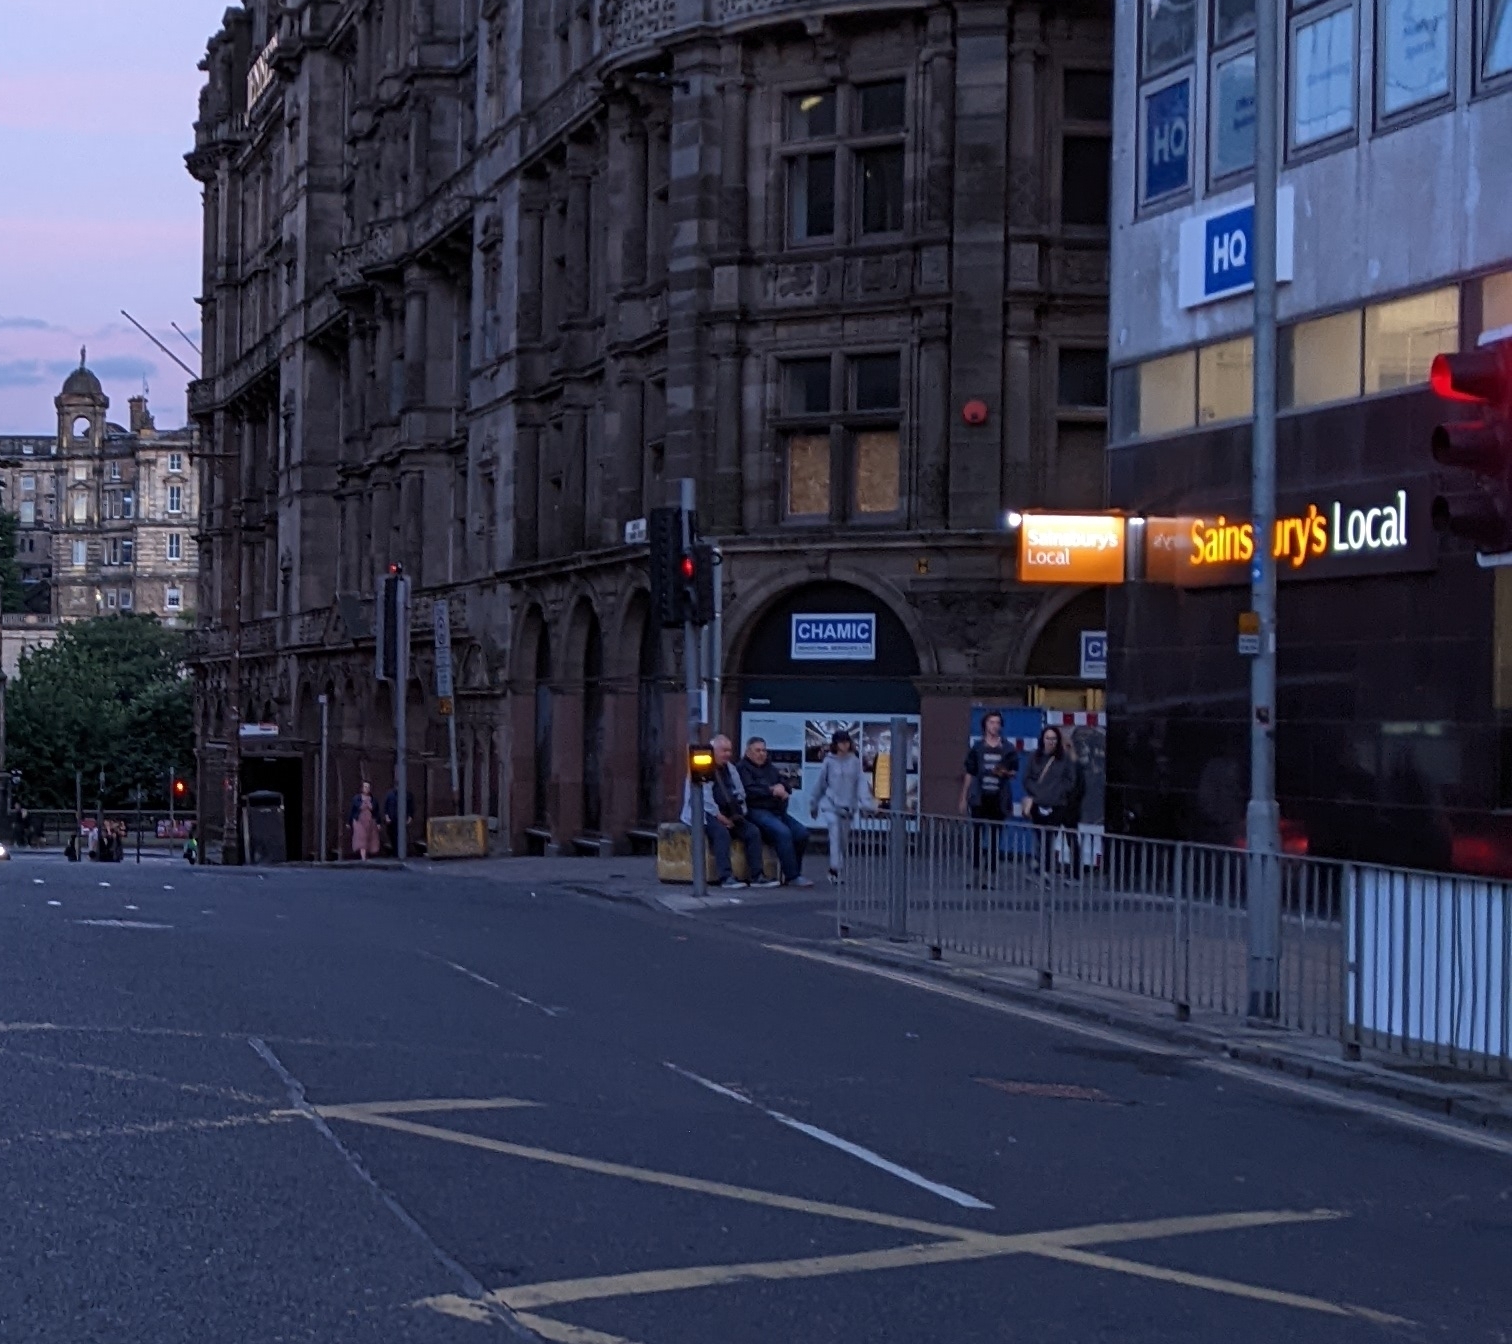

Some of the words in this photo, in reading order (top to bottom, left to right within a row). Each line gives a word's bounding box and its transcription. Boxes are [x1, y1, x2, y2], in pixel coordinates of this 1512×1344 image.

[1153, 116, 1187, 166] HQ
[1213, 229, 1247, 274] HQ
[1333, 489, 1407, 551] Local
[1027, 548, 1071, 565] Local
[798, 622, 870, 639] CHAMIC
